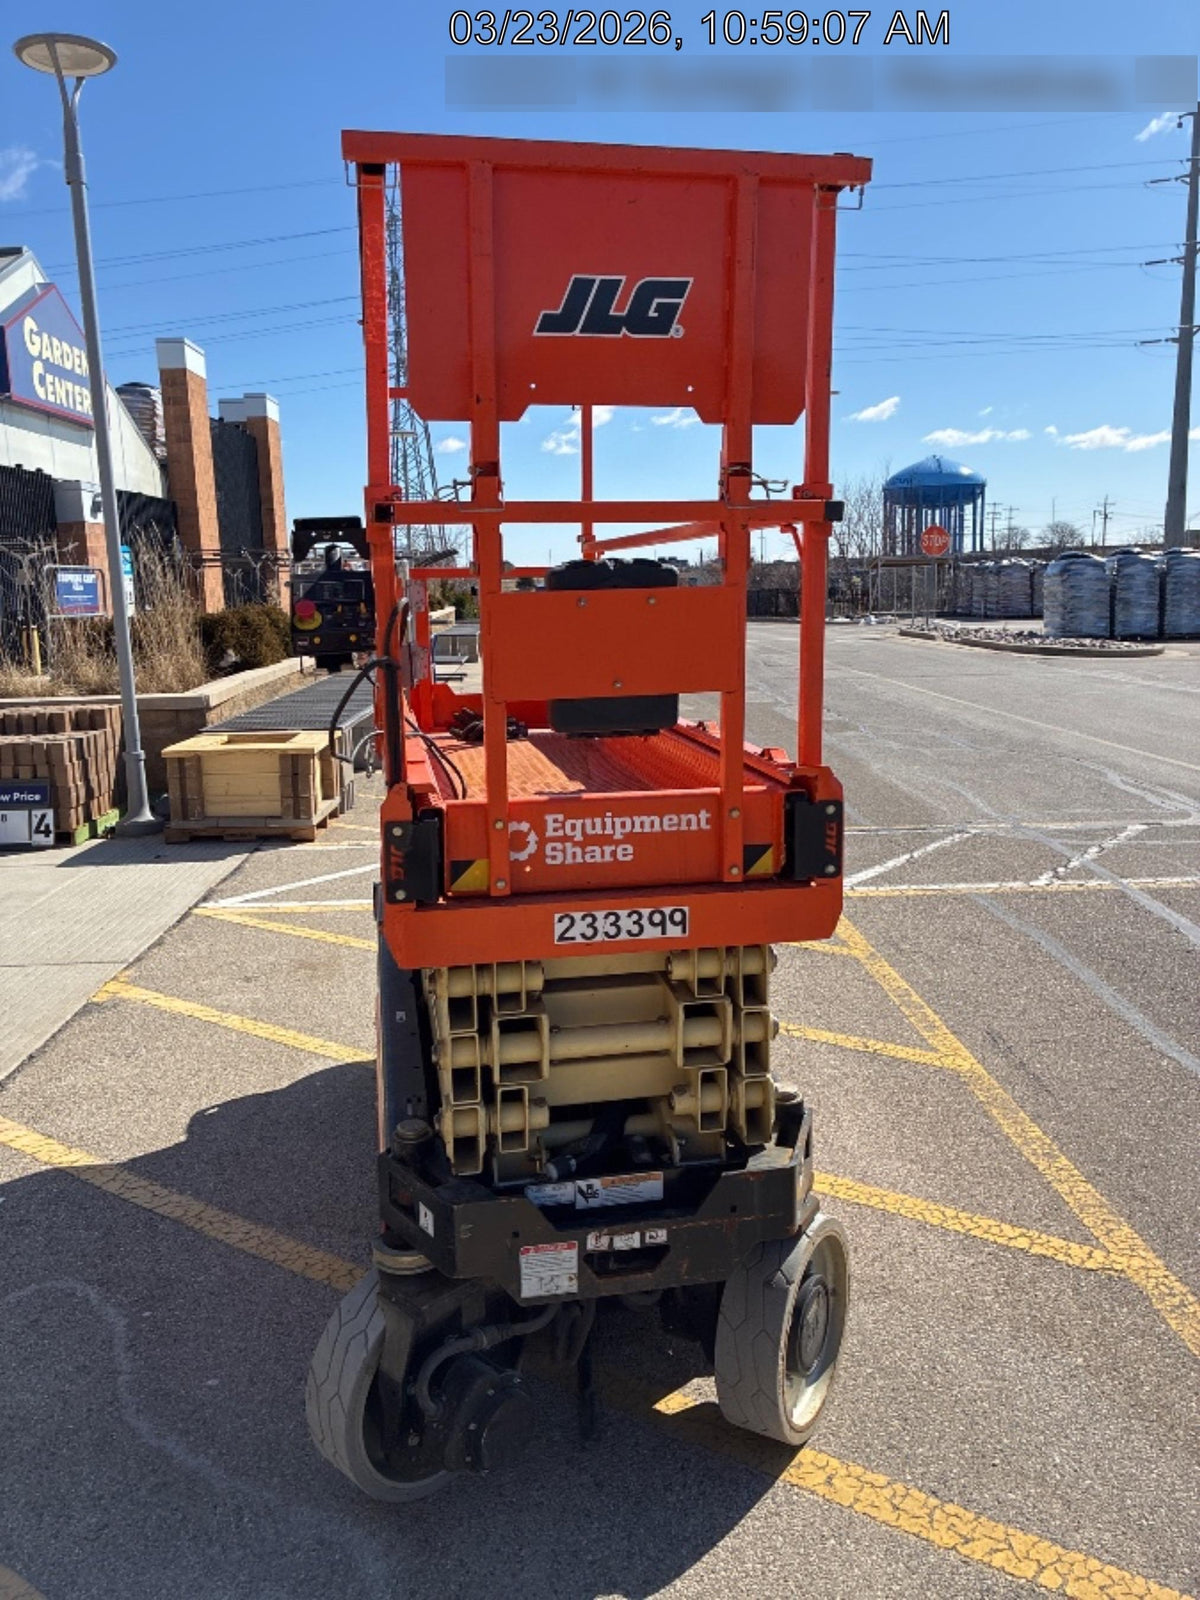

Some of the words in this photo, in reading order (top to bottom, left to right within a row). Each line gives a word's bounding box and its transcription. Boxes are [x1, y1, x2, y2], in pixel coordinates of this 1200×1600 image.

[533, 274, 694, 338] JLG
[24, 316, 90, 377] GARDEN
[33, 361, 93, 416] CENTER
[922, 534, 949, 547] STOP
[13, 790, 41, 801] Price
[545, 809, 711, 841] Equipment
[545, 842, 634, 865] Share
[556, 907, 687, 943] 233399
